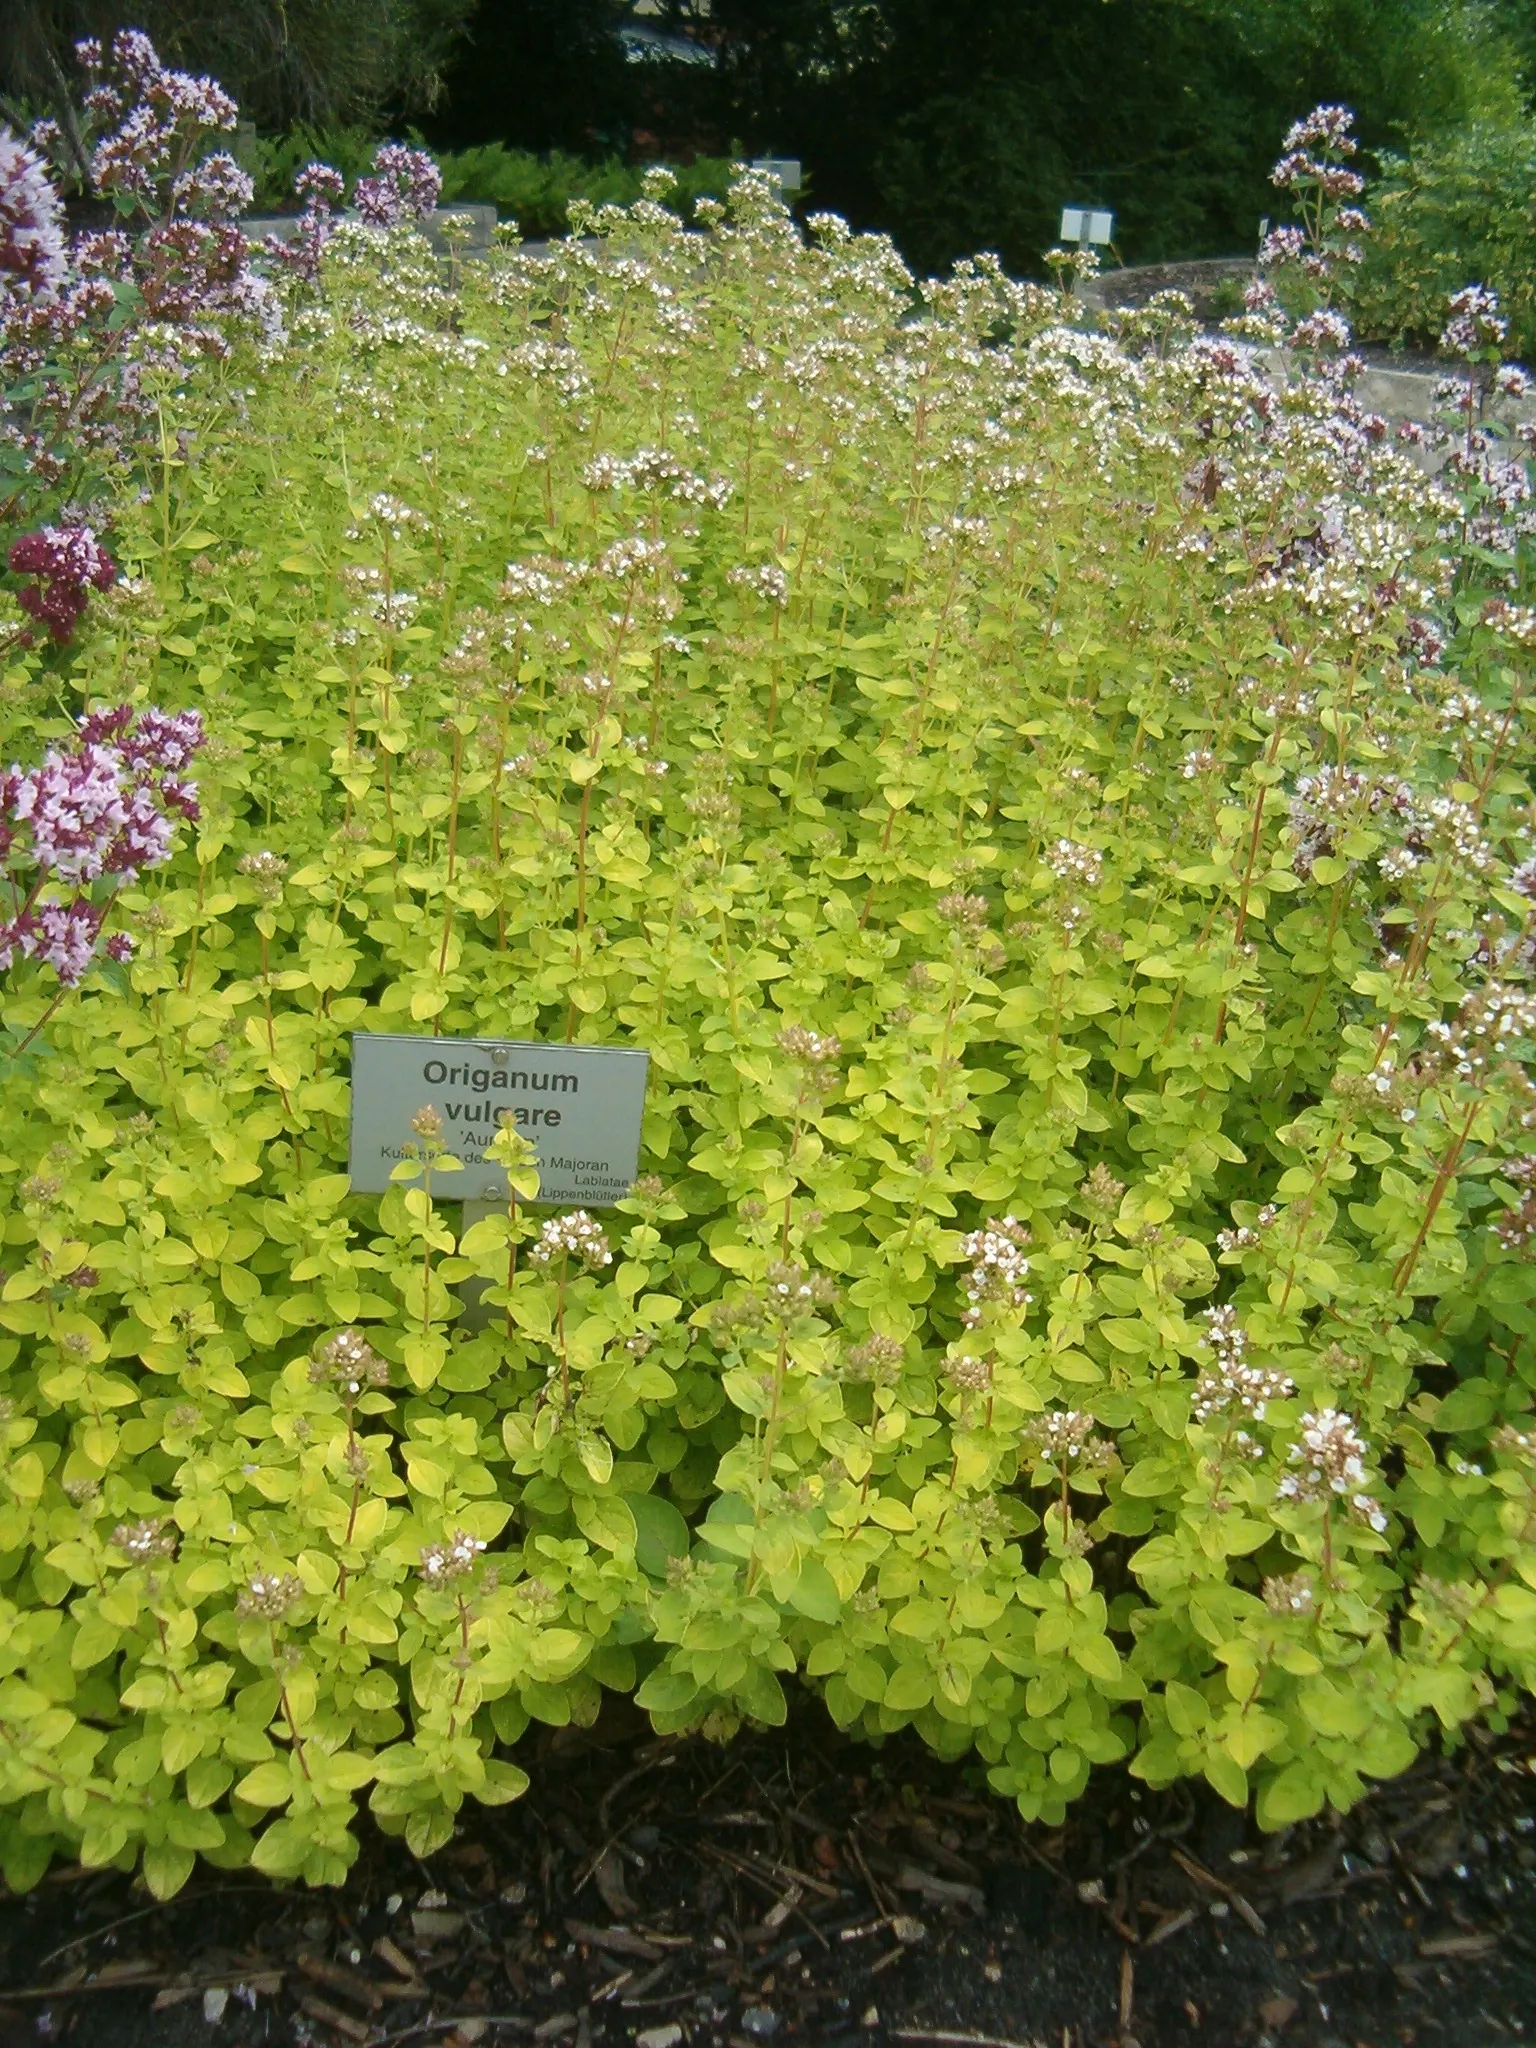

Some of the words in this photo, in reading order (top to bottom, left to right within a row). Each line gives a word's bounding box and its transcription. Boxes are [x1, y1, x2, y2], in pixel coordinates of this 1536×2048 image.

[423, 1060, 579, 1093] Origanum
[550, 1156, 609, 1173] Majoran
[574, 1174, 629, 1188] Labiatae
